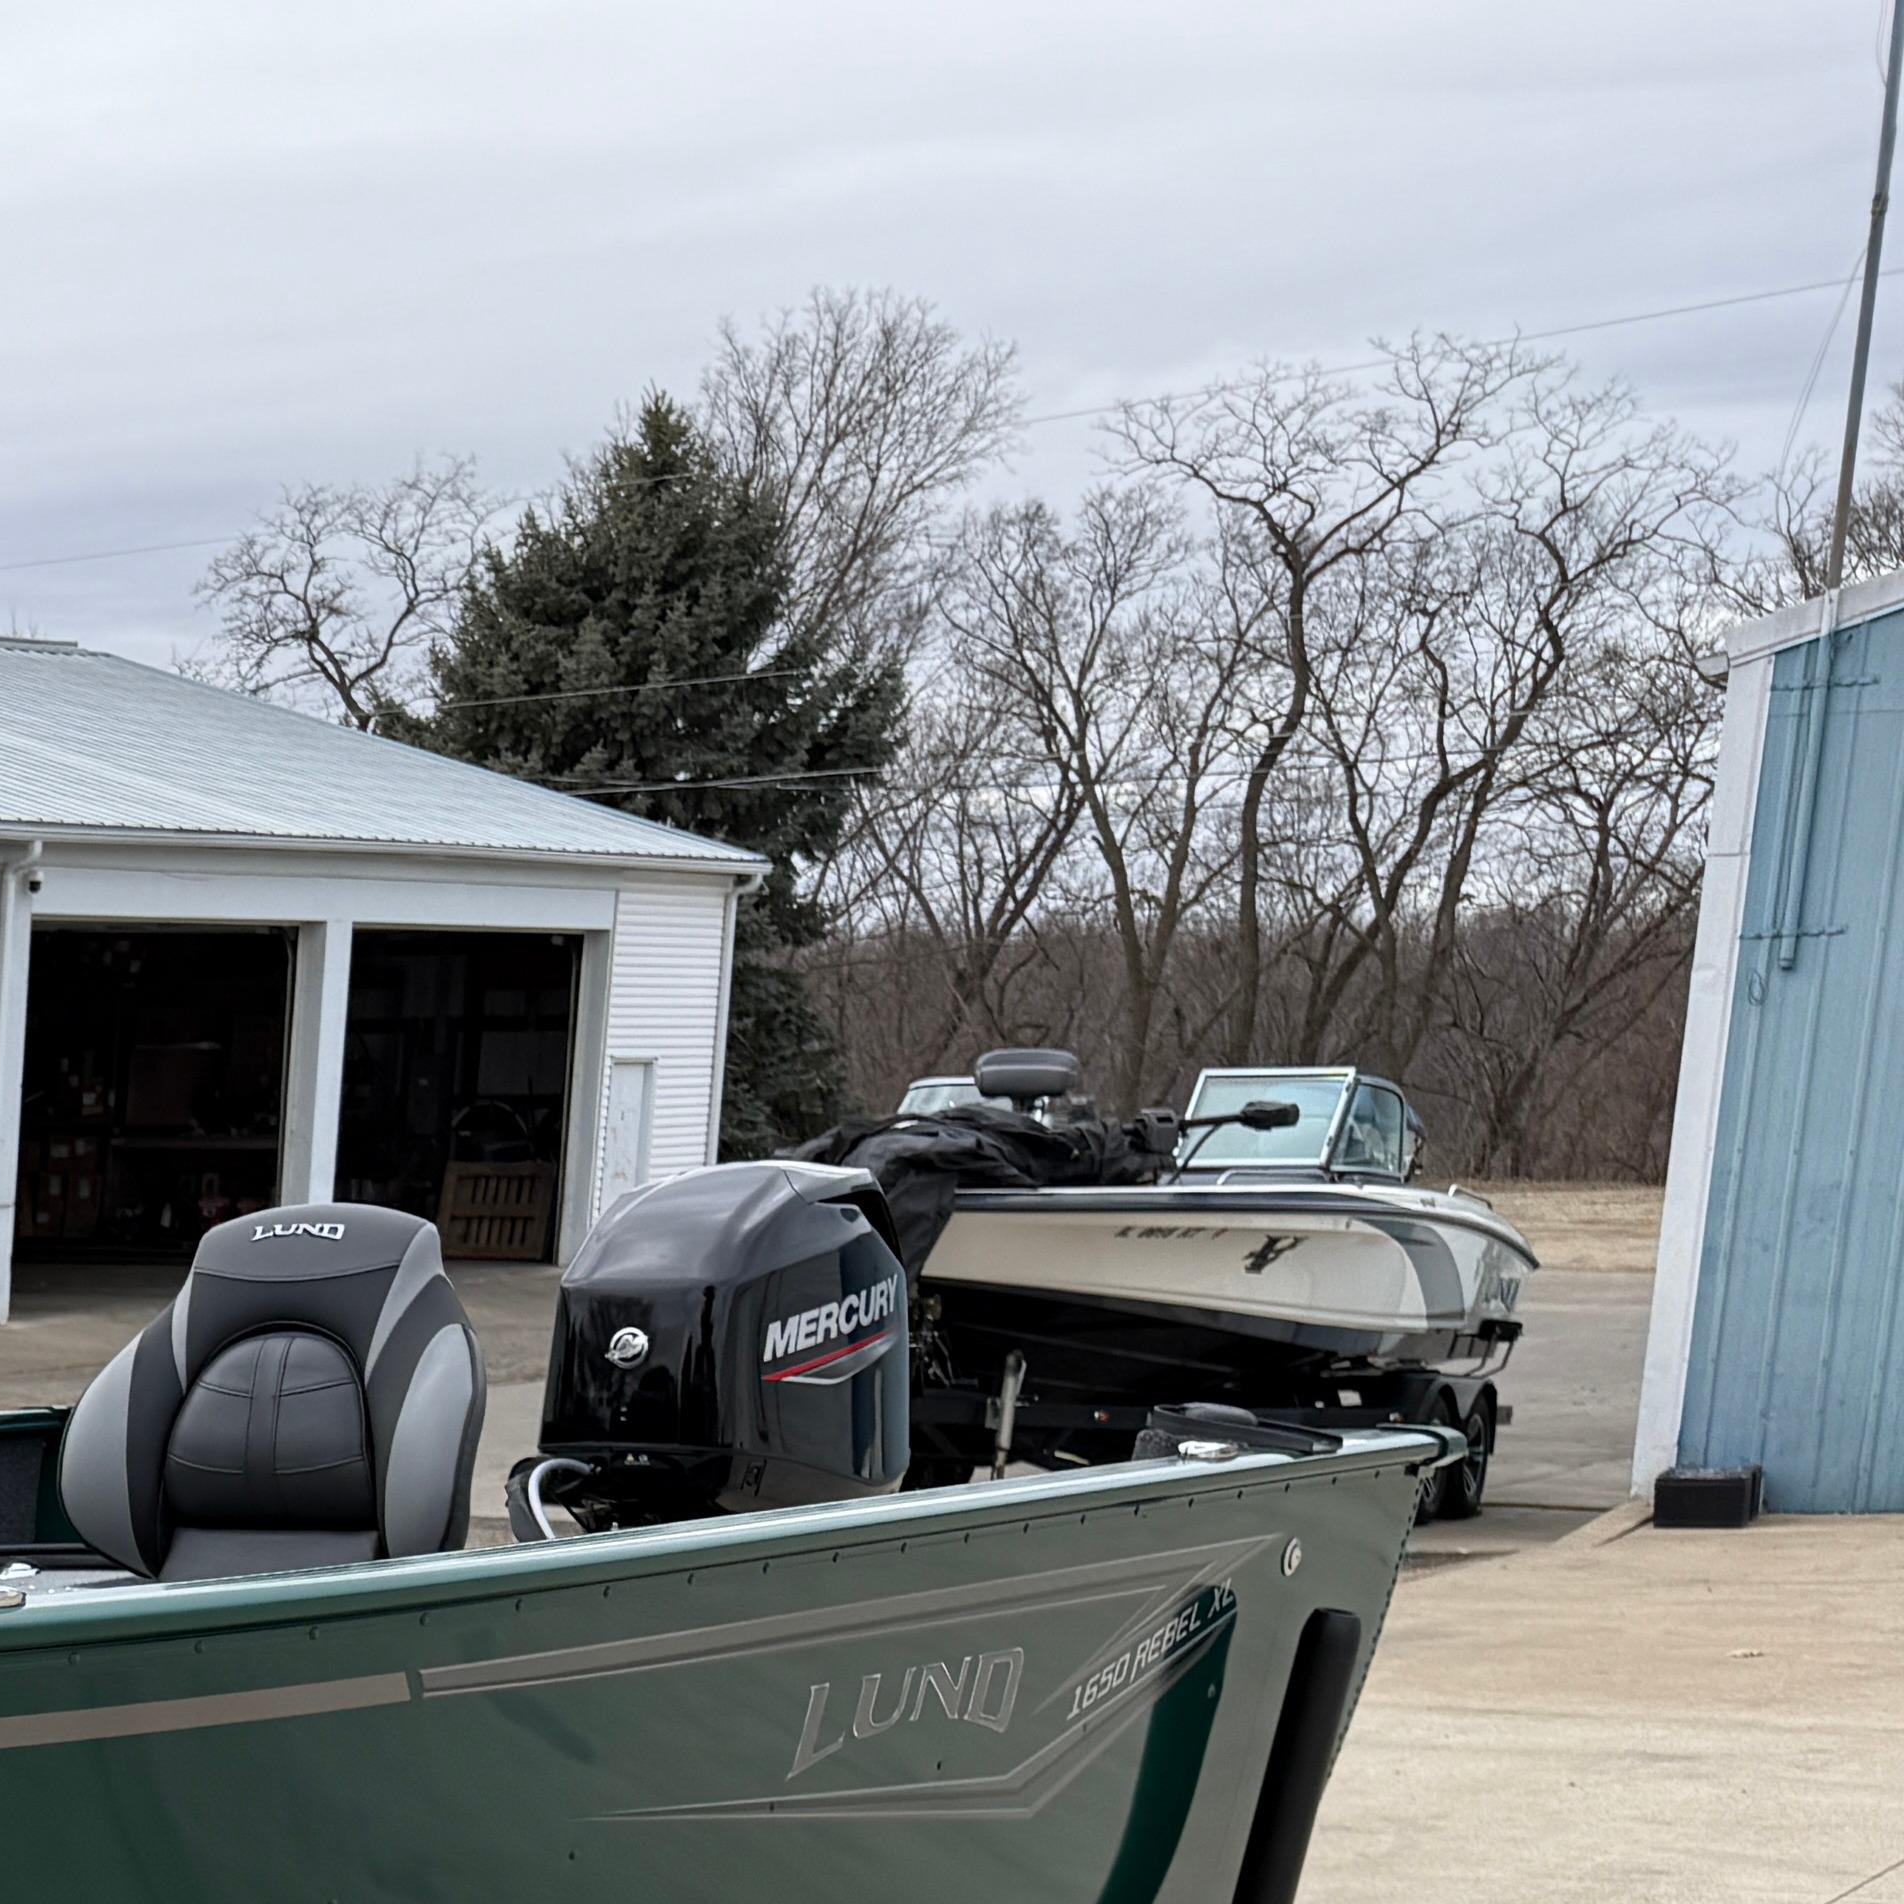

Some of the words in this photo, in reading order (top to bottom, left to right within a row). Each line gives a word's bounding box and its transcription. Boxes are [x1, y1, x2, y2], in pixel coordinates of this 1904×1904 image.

[251, 1223, 345, 1241] LUND
[763, 1274, 898, 1363] MERCURY
[1066, 1653, 1131, 1720] 1650
[1129, 1602, 1201, 1683] REBEL
[1207, 1578, 1234, 1618] XL
[785, 1647, 1024, 1781] LUND
